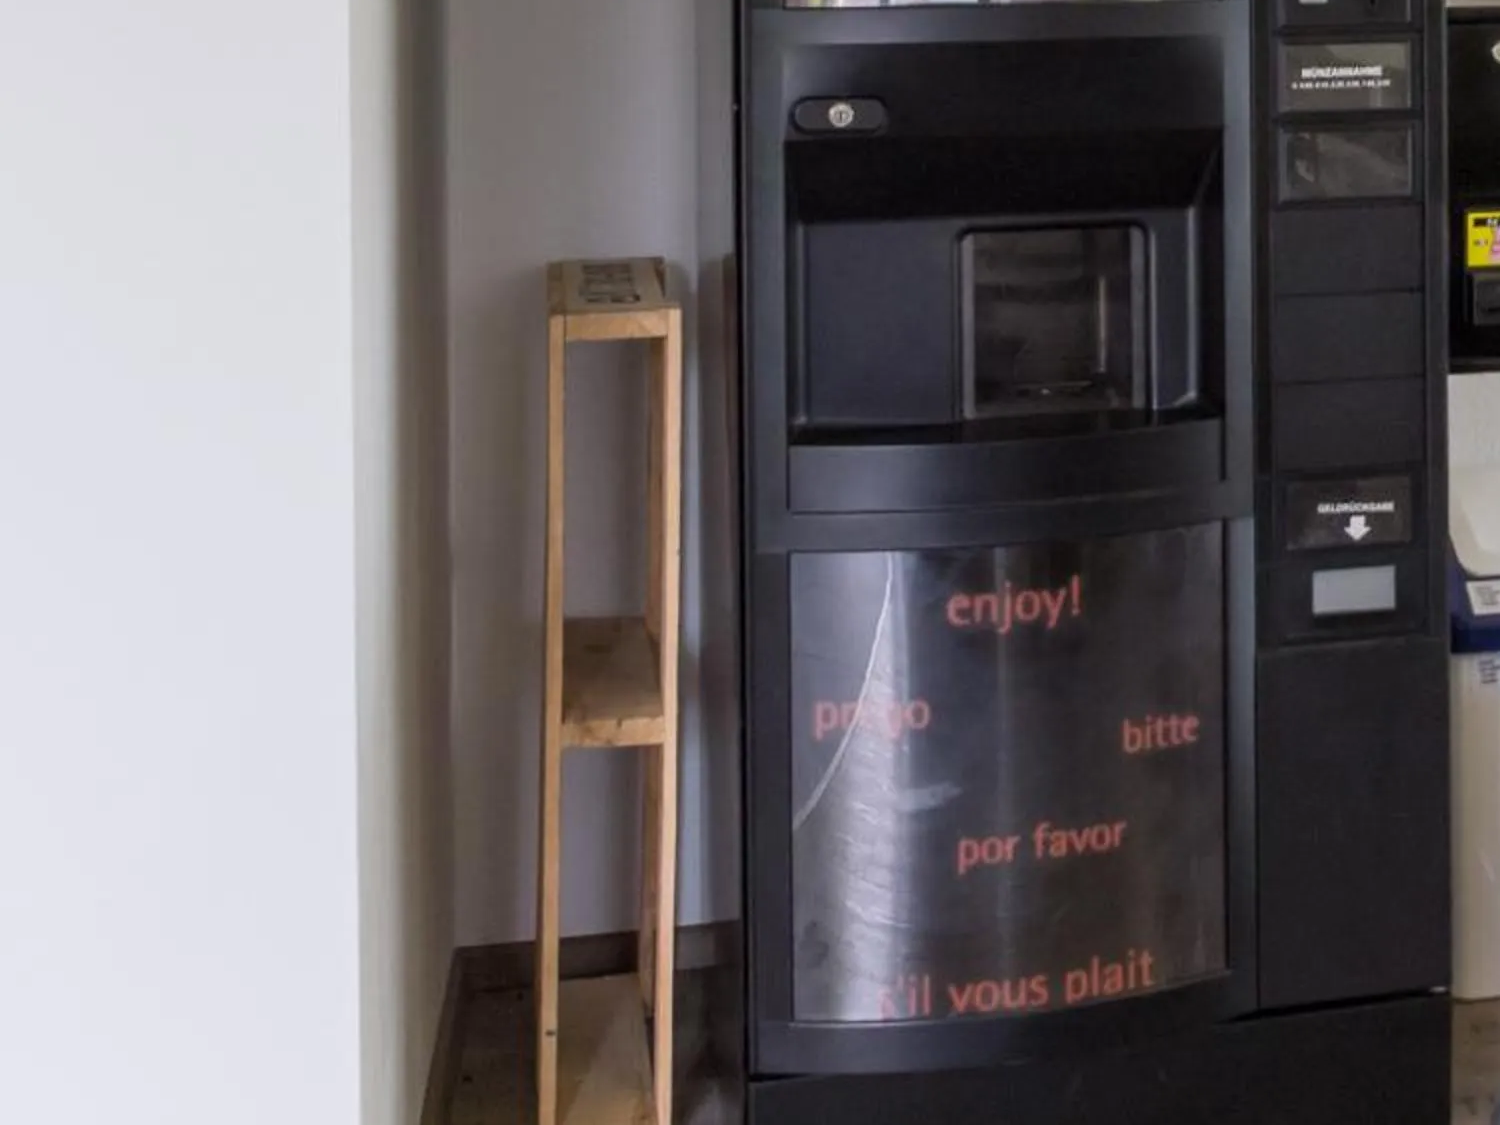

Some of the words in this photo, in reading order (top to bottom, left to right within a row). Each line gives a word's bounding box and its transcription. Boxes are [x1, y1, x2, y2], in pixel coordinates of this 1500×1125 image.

[946, 574, 1082, 635] enjoy!
[812, 696, 932, 742] prgo
[1121, 711, 1200, 755] bitte
[956, 833, 1021, 875] por
[1033, 819, 1128, 860] favor
[949, 974, 1050, 1015] vous
